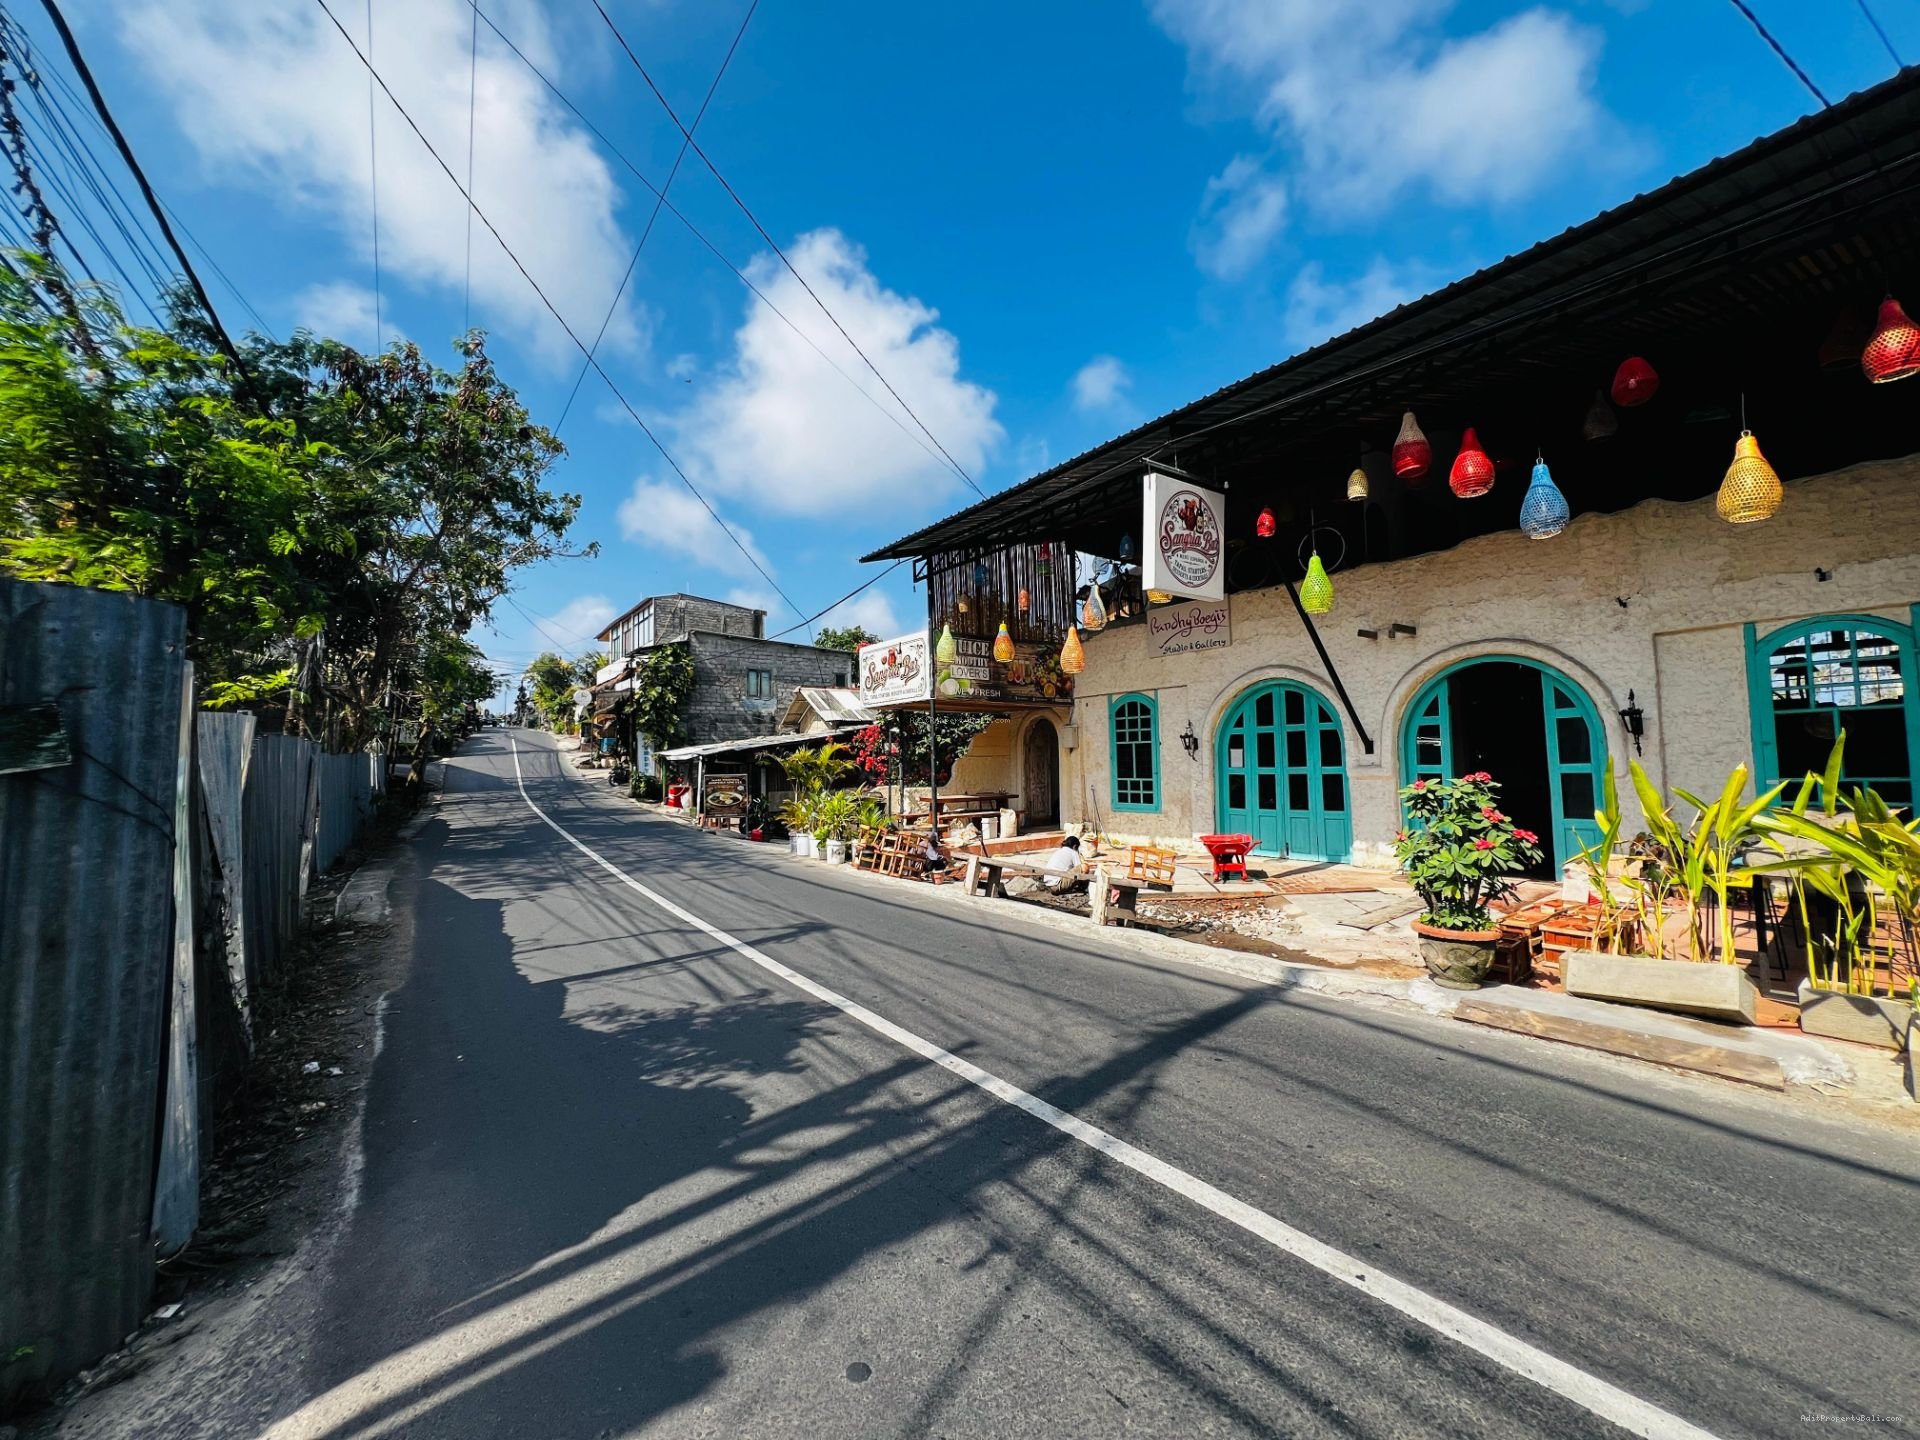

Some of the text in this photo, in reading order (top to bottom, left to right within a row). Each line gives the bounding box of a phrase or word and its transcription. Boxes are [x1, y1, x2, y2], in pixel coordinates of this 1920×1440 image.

[1160, 520, 1219, 552] Sangria Bar
[956, 640, 990, 656] UICE
[1195, 639, 1226, 650] Gallery
[864, 654, 920, 691] Sangria Bar
[951, 667, 988, 679] LOVER'S
[975, 688, 1002, 698] FRESH
